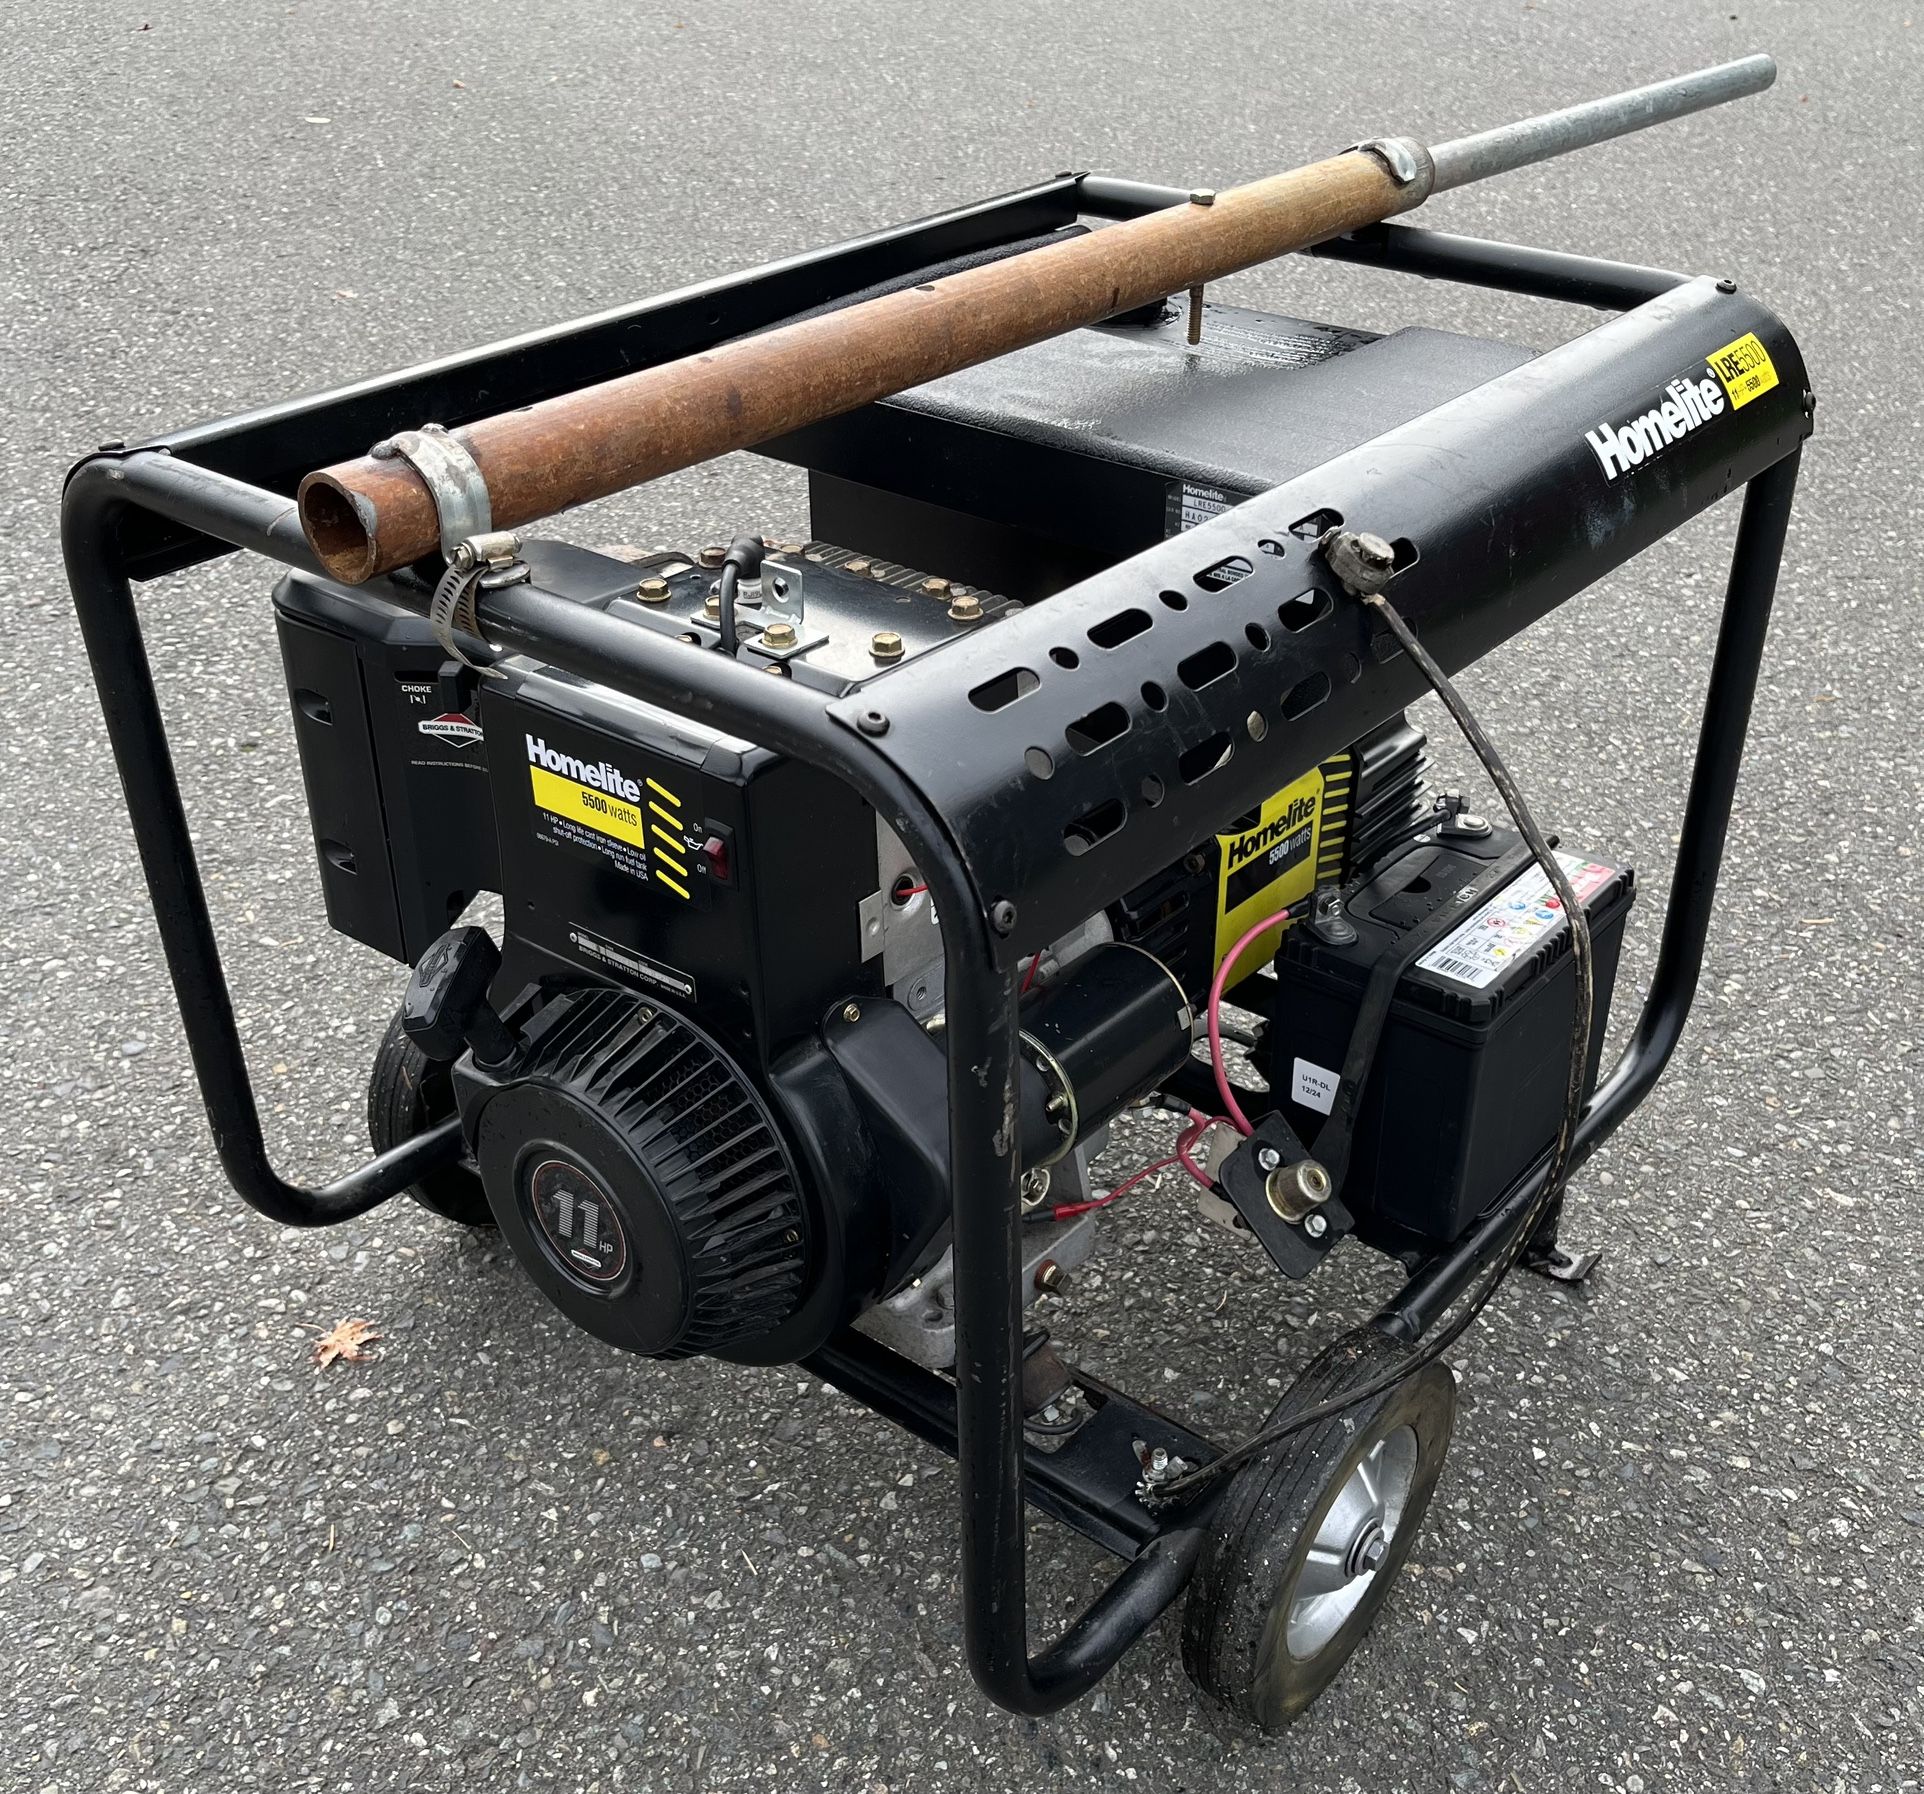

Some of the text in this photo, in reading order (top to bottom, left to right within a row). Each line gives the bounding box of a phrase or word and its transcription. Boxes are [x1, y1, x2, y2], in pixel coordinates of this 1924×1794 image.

[1714, 340, 1766, 383] LRE5500
[1584, 378, 1725, 480] Homelite
[1182, 484, 1224, 502] Homelite
[1193, 499, 1226, 513] LRE5500
[401, 685, 432, 693] CHOKE
[456, 726, 482, 736] STRATTO
[525, 733, 641, 803] Homelite
[581, 791, 638, 827] 5500 watts
[542, 812, 550, 821] 11
[550, 814, 559, 824] HP
[562, 820, 576, 834] Long
[584, 830, 596, 840] cast
[595, 834, 607, 845] iron
[626, 847, 639, 858] Low
[639, 853, 647, 862] oil
[693, 822, 703, 834] On
[1228, 796, 1316, 870] Homelite
[572, 835, 598, 850] protection
[601, 844, 615, 859] Long
[615, 852, 625, 862] run
[625, 855, 635, 867] fuel
[635, 859, 648, 871] tank
[1269, 827, 1311, 865] 5500 watts
[614, 860, 649, 882] Made in USA
[578, 945, 601, 960] BRIGGS
[607, 959, 639, 978] STRATTON
[1301, 1085, 1321, 1099] 12/24
[1302, 1074, 1331, 1092] U1R-DL
[553, 1188, 614, 1254] 11 HP
